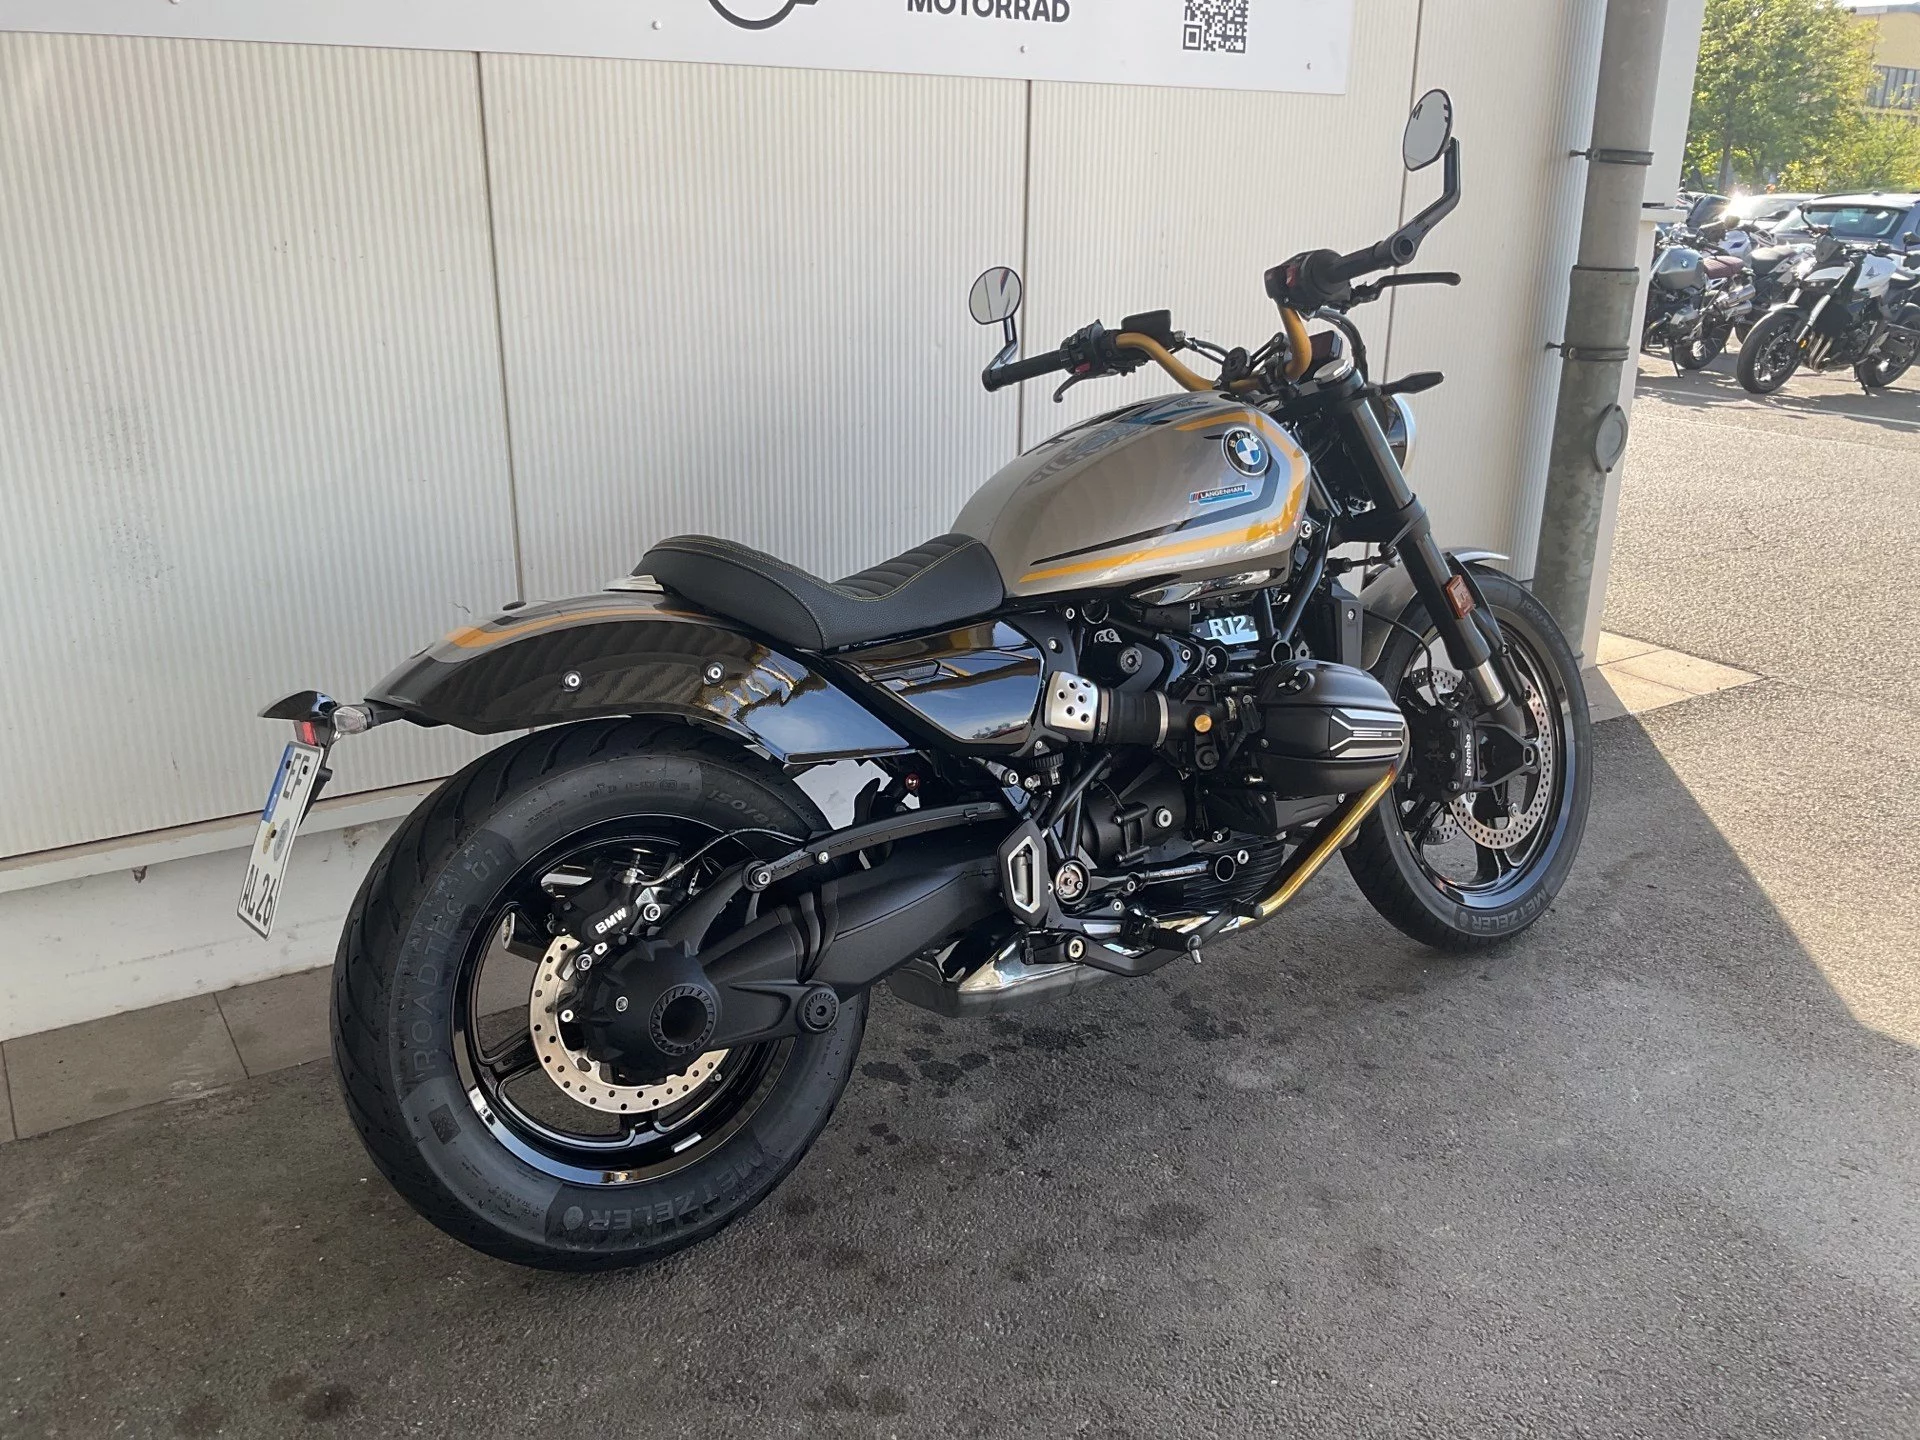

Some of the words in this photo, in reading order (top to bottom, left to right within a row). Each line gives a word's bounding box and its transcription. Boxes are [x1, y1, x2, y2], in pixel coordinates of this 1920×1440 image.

[907, 0, 1070, 23] MOTORRAD
[1200, 486, 1243, 499] LANGENHAN
[1208, 616, 1249, 637] R12
[1464, 733, 1472, 777] brembo
[282, 752, 311, 800] EF
[595, 907, 627, 934] BMW
[1471, 887, 1549, 931] METZELER
[589, 1151, 766, 1231] METZELER
